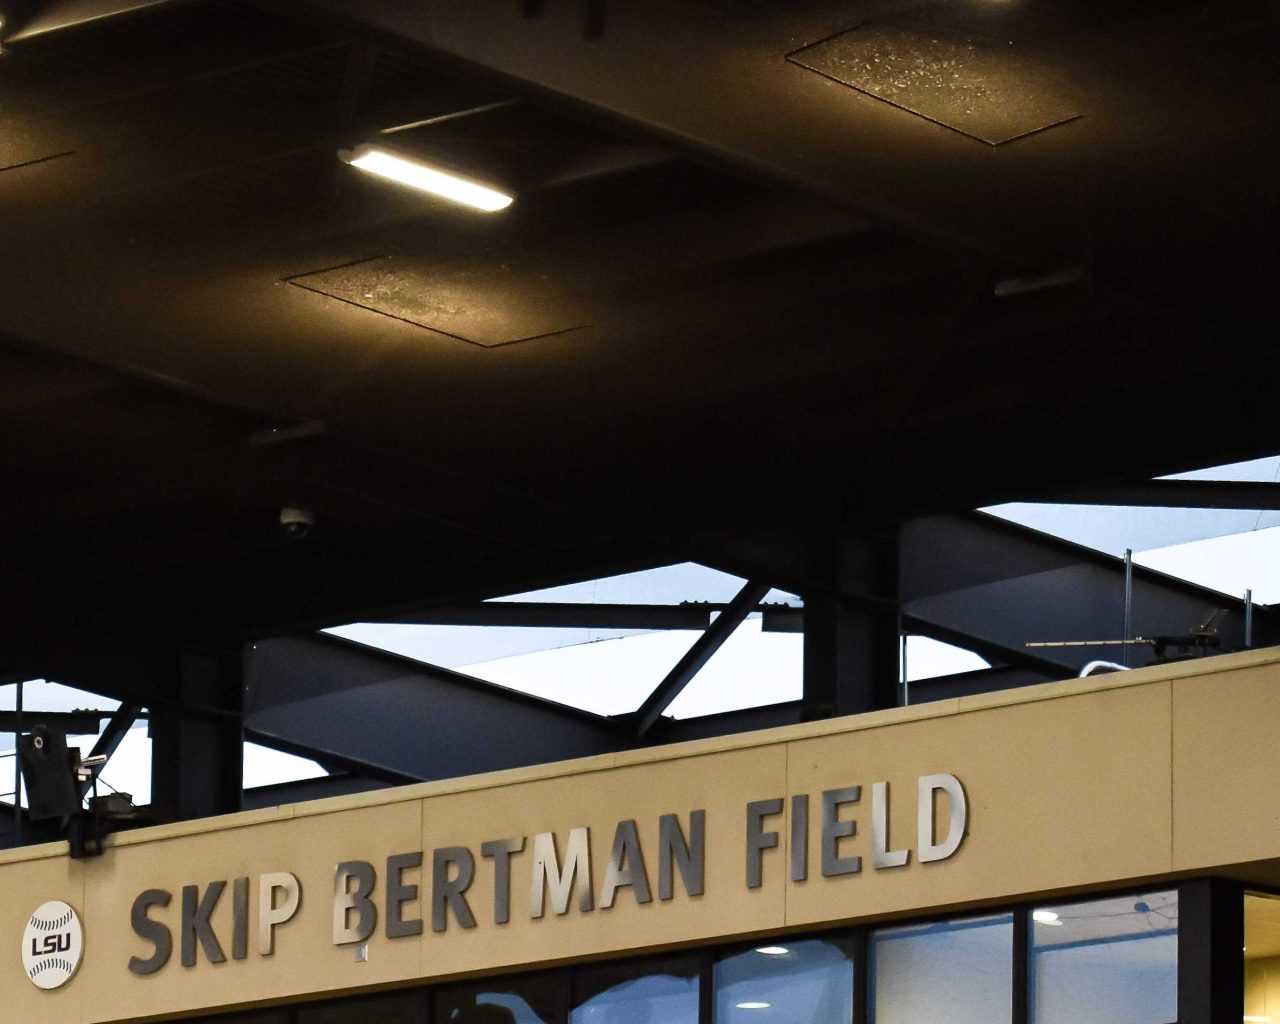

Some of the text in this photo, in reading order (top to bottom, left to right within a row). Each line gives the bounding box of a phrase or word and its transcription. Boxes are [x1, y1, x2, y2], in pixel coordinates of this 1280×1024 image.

[126, 772, 970, 974] SKIP BERTMAN FIELD
[32, 933, 70, 956] LSU
